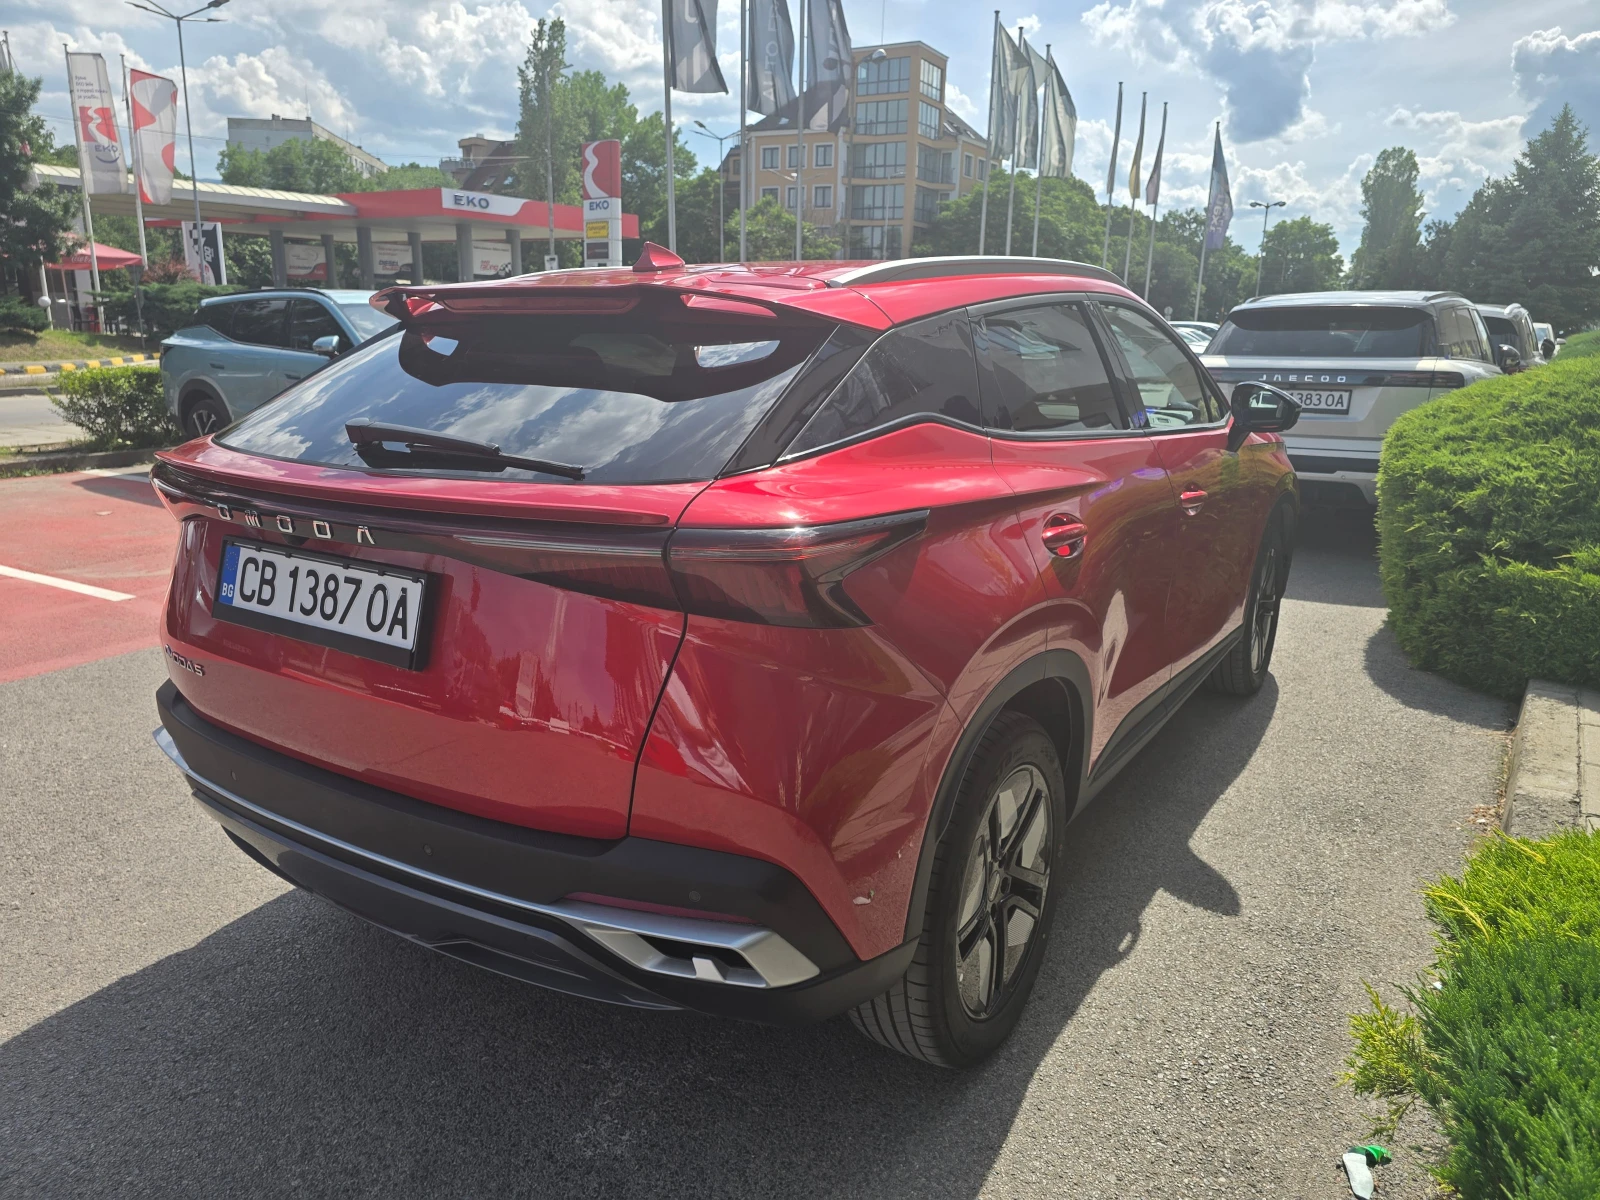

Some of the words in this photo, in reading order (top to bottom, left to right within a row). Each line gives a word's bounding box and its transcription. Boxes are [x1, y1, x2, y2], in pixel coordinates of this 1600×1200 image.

[94, 144, 118, 153] EKO
[453, 193, 490, 209] EKO
[589, 200, 610, 211] EKO
[1258, 374, 1347, 383] JAECOO
[1290, 392, 1322, 407] 383
[1325, 394, 1345, 408] OA
[217, 504, 375, 544] OMODA
[222, 582, 234, 598] BG
[239, 556, 277, 607] CB
[288, 565, 362, 625] 1387
[366, 583, 408, 640] OA
